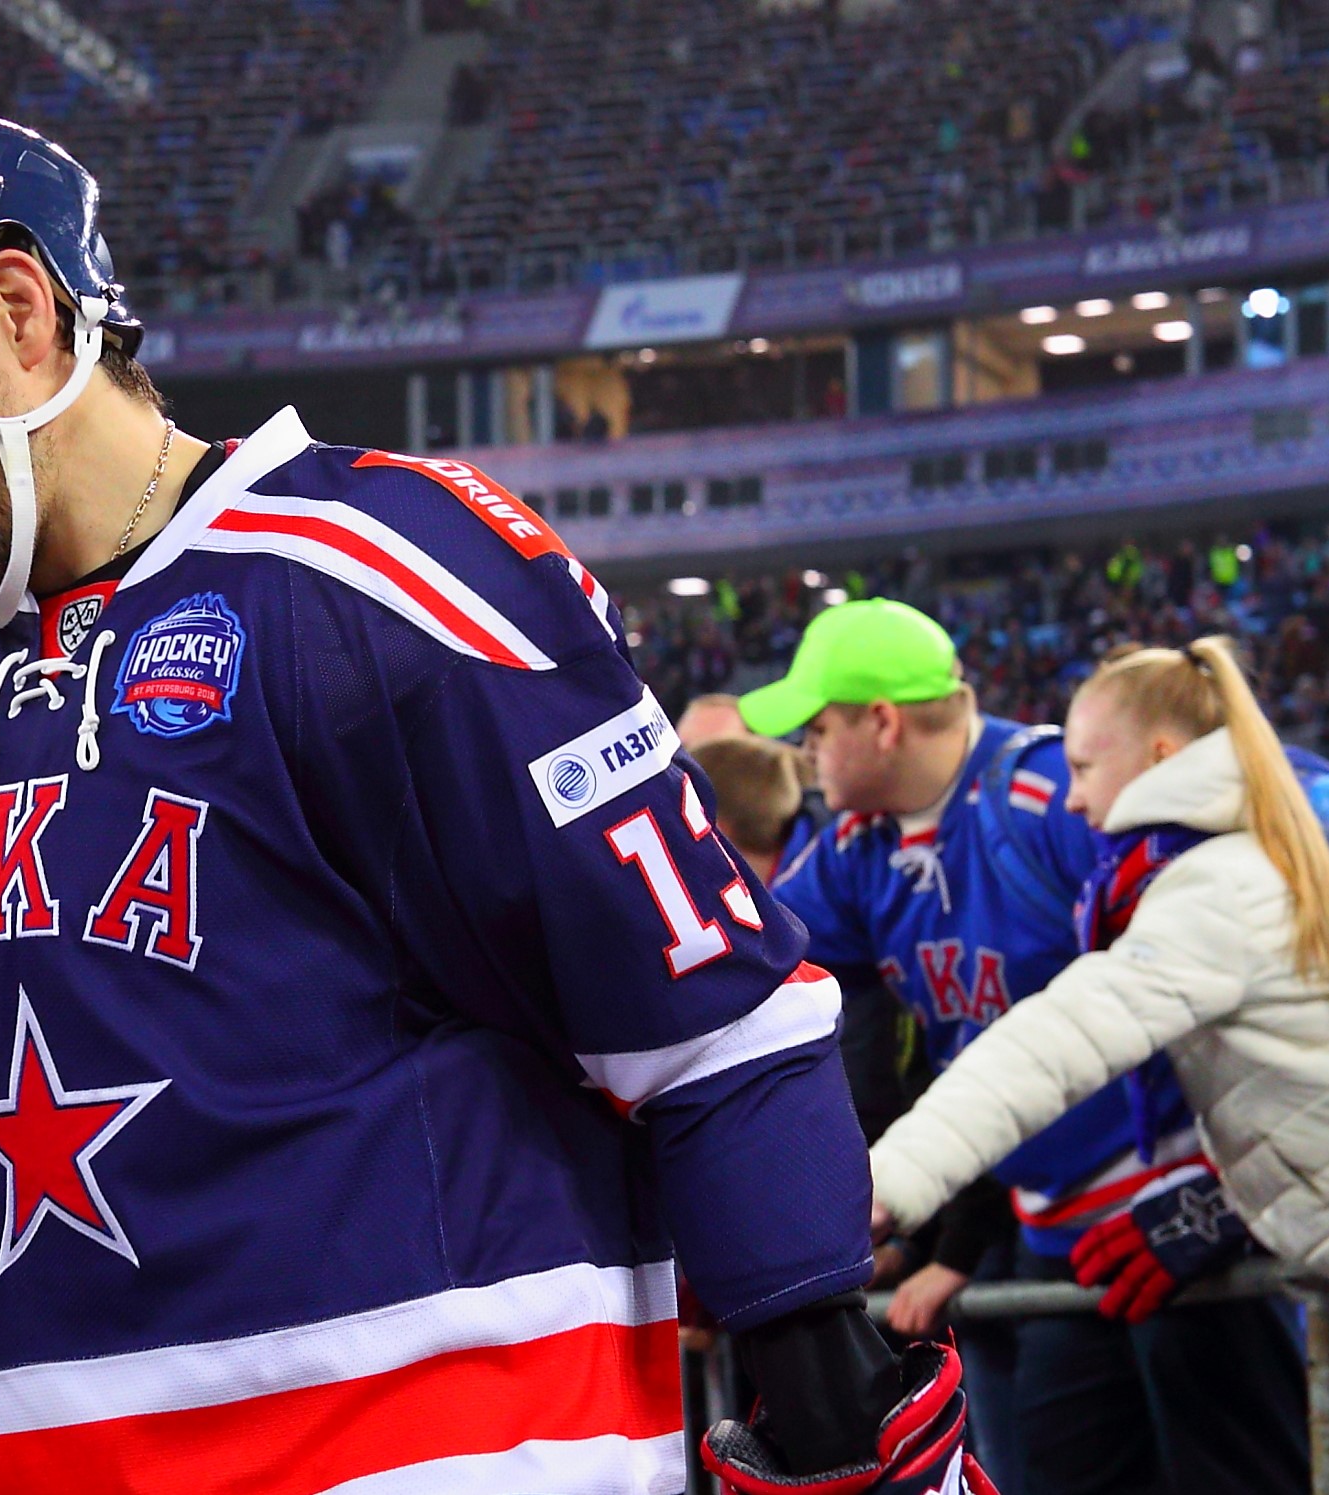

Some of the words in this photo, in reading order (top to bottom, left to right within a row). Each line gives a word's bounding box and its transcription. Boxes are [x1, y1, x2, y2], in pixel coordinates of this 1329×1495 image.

[131, 633, 231, 678] HOCKEY
[151, 661, 205, 681] classic
[145, 684, 196, 696] PETERSBURG
[197, 689, 216, 700] 2018
